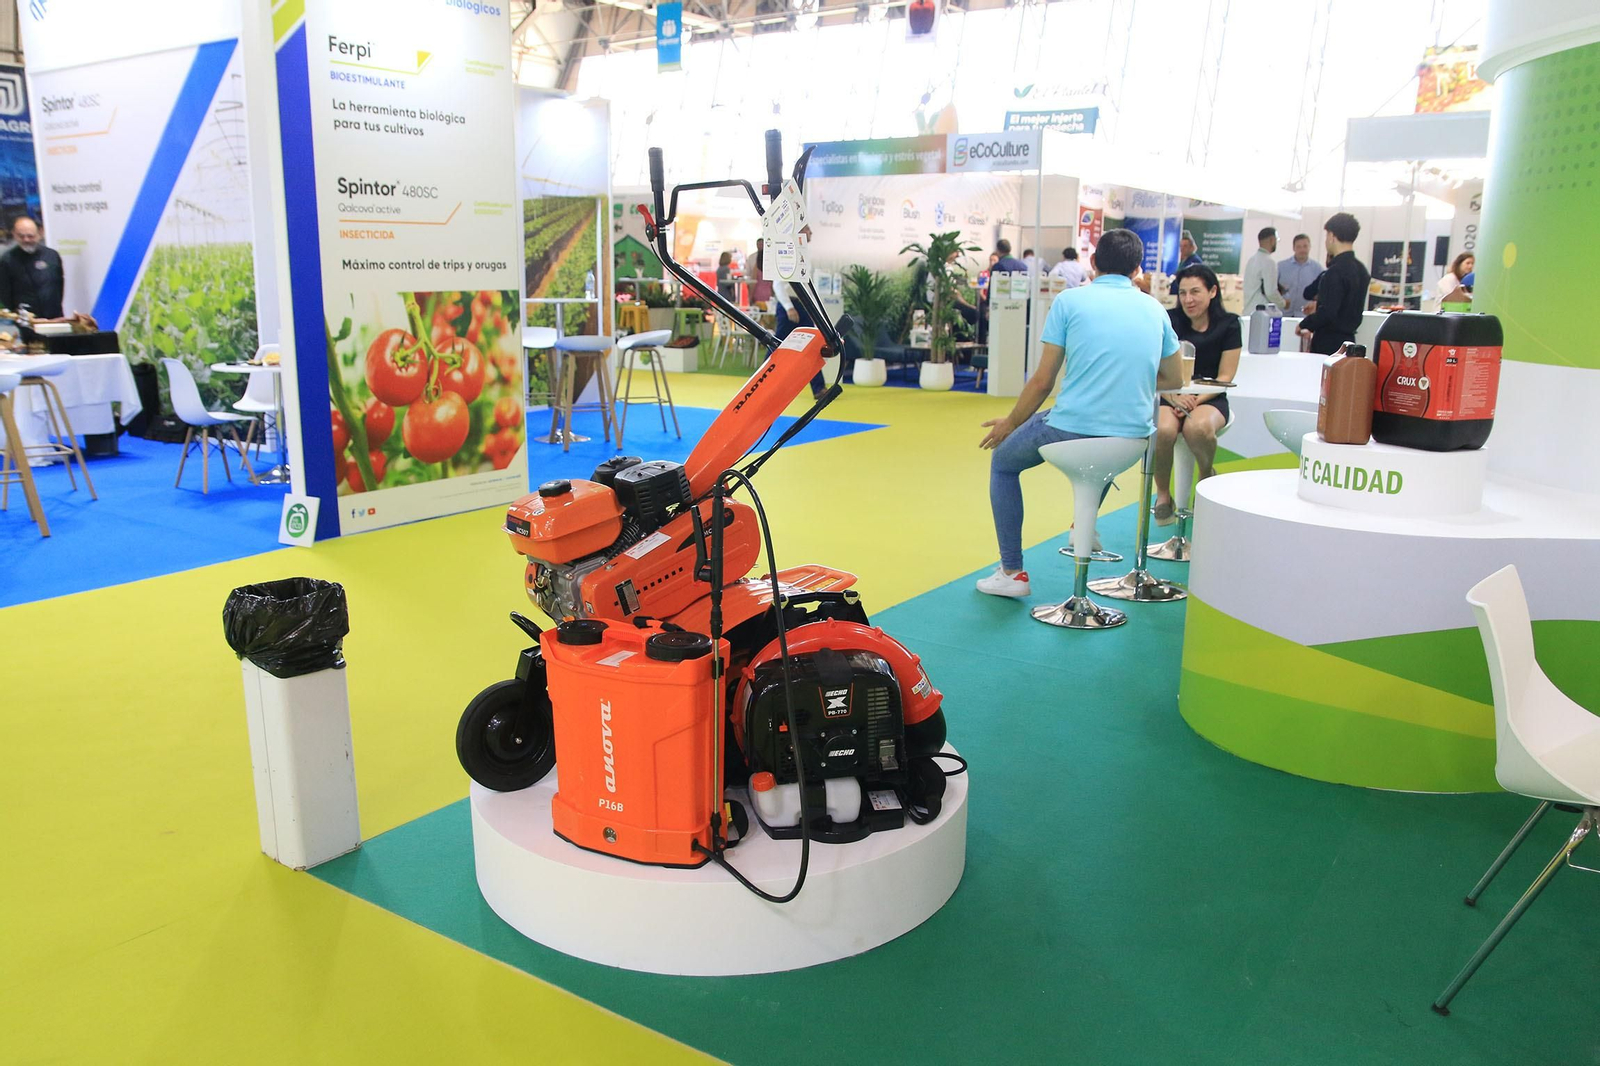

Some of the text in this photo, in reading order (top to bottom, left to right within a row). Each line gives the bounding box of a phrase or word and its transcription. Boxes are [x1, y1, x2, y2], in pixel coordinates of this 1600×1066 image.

[328, 35, 372, 60] Ferpi
[330, 70, 406, 90] BIOESTIMULANTE
[332, 98, 466, 125] La herramienta biológica
[334, 118, 424, 137] para tus cultivos
[969, 141, 1029, 159] eCoCulture
[338, 177, 439, 200] Spintor 480SC
[339, 230, 395, 240] INSECTICIDA
[342, 257, 507, 273] Máximo control de trips y orugas
[1396, 376, 1416, 388] CRUX
[1312, 459, 1404, 495] CALIDAD
[829, 688, 849, 697] ECHO
[832, 748, 855, 757] ECHO
[598, 798, 624, 812] P16B
